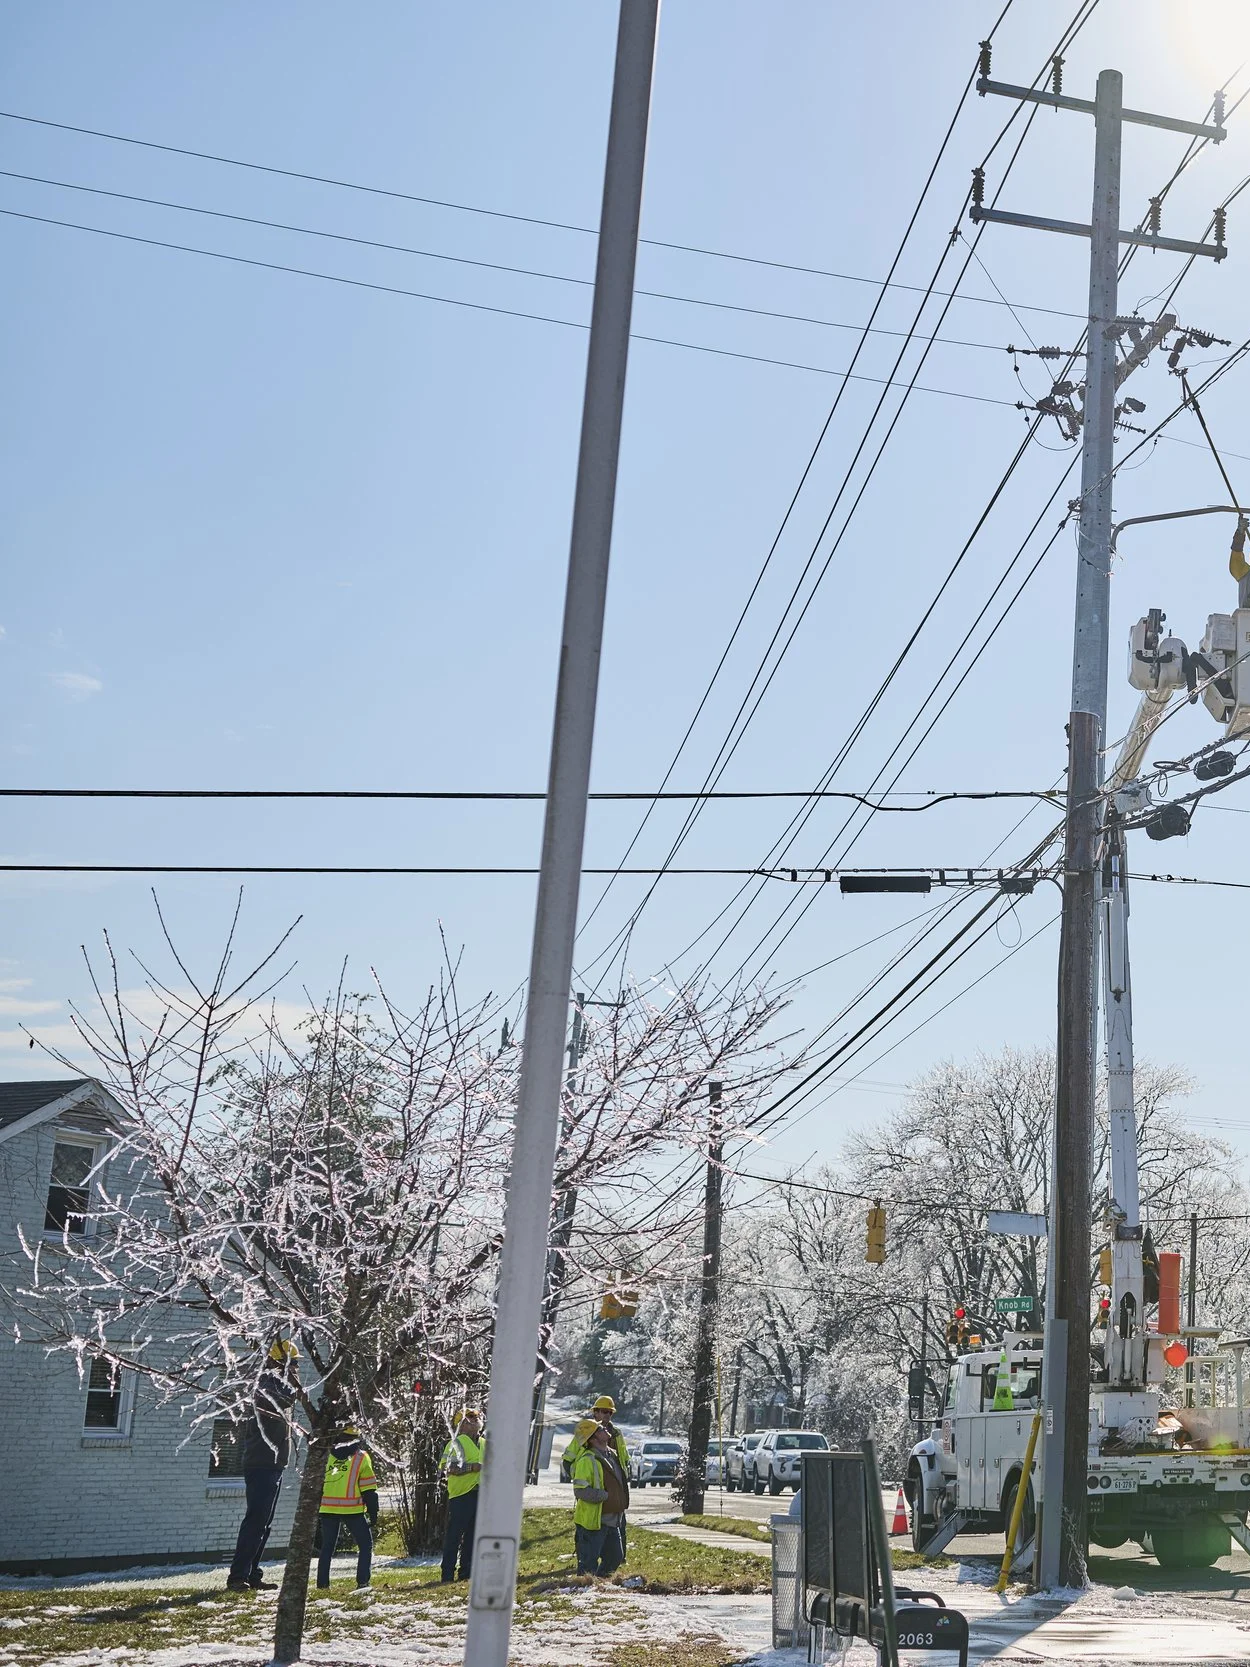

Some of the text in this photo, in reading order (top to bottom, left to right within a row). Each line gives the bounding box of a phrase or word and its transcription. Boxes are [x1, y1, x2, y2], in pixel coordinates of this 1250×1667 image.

[998, 1300, 1030, 1310] Knob Rd
[898, 1632, 933, 1646] 2063
